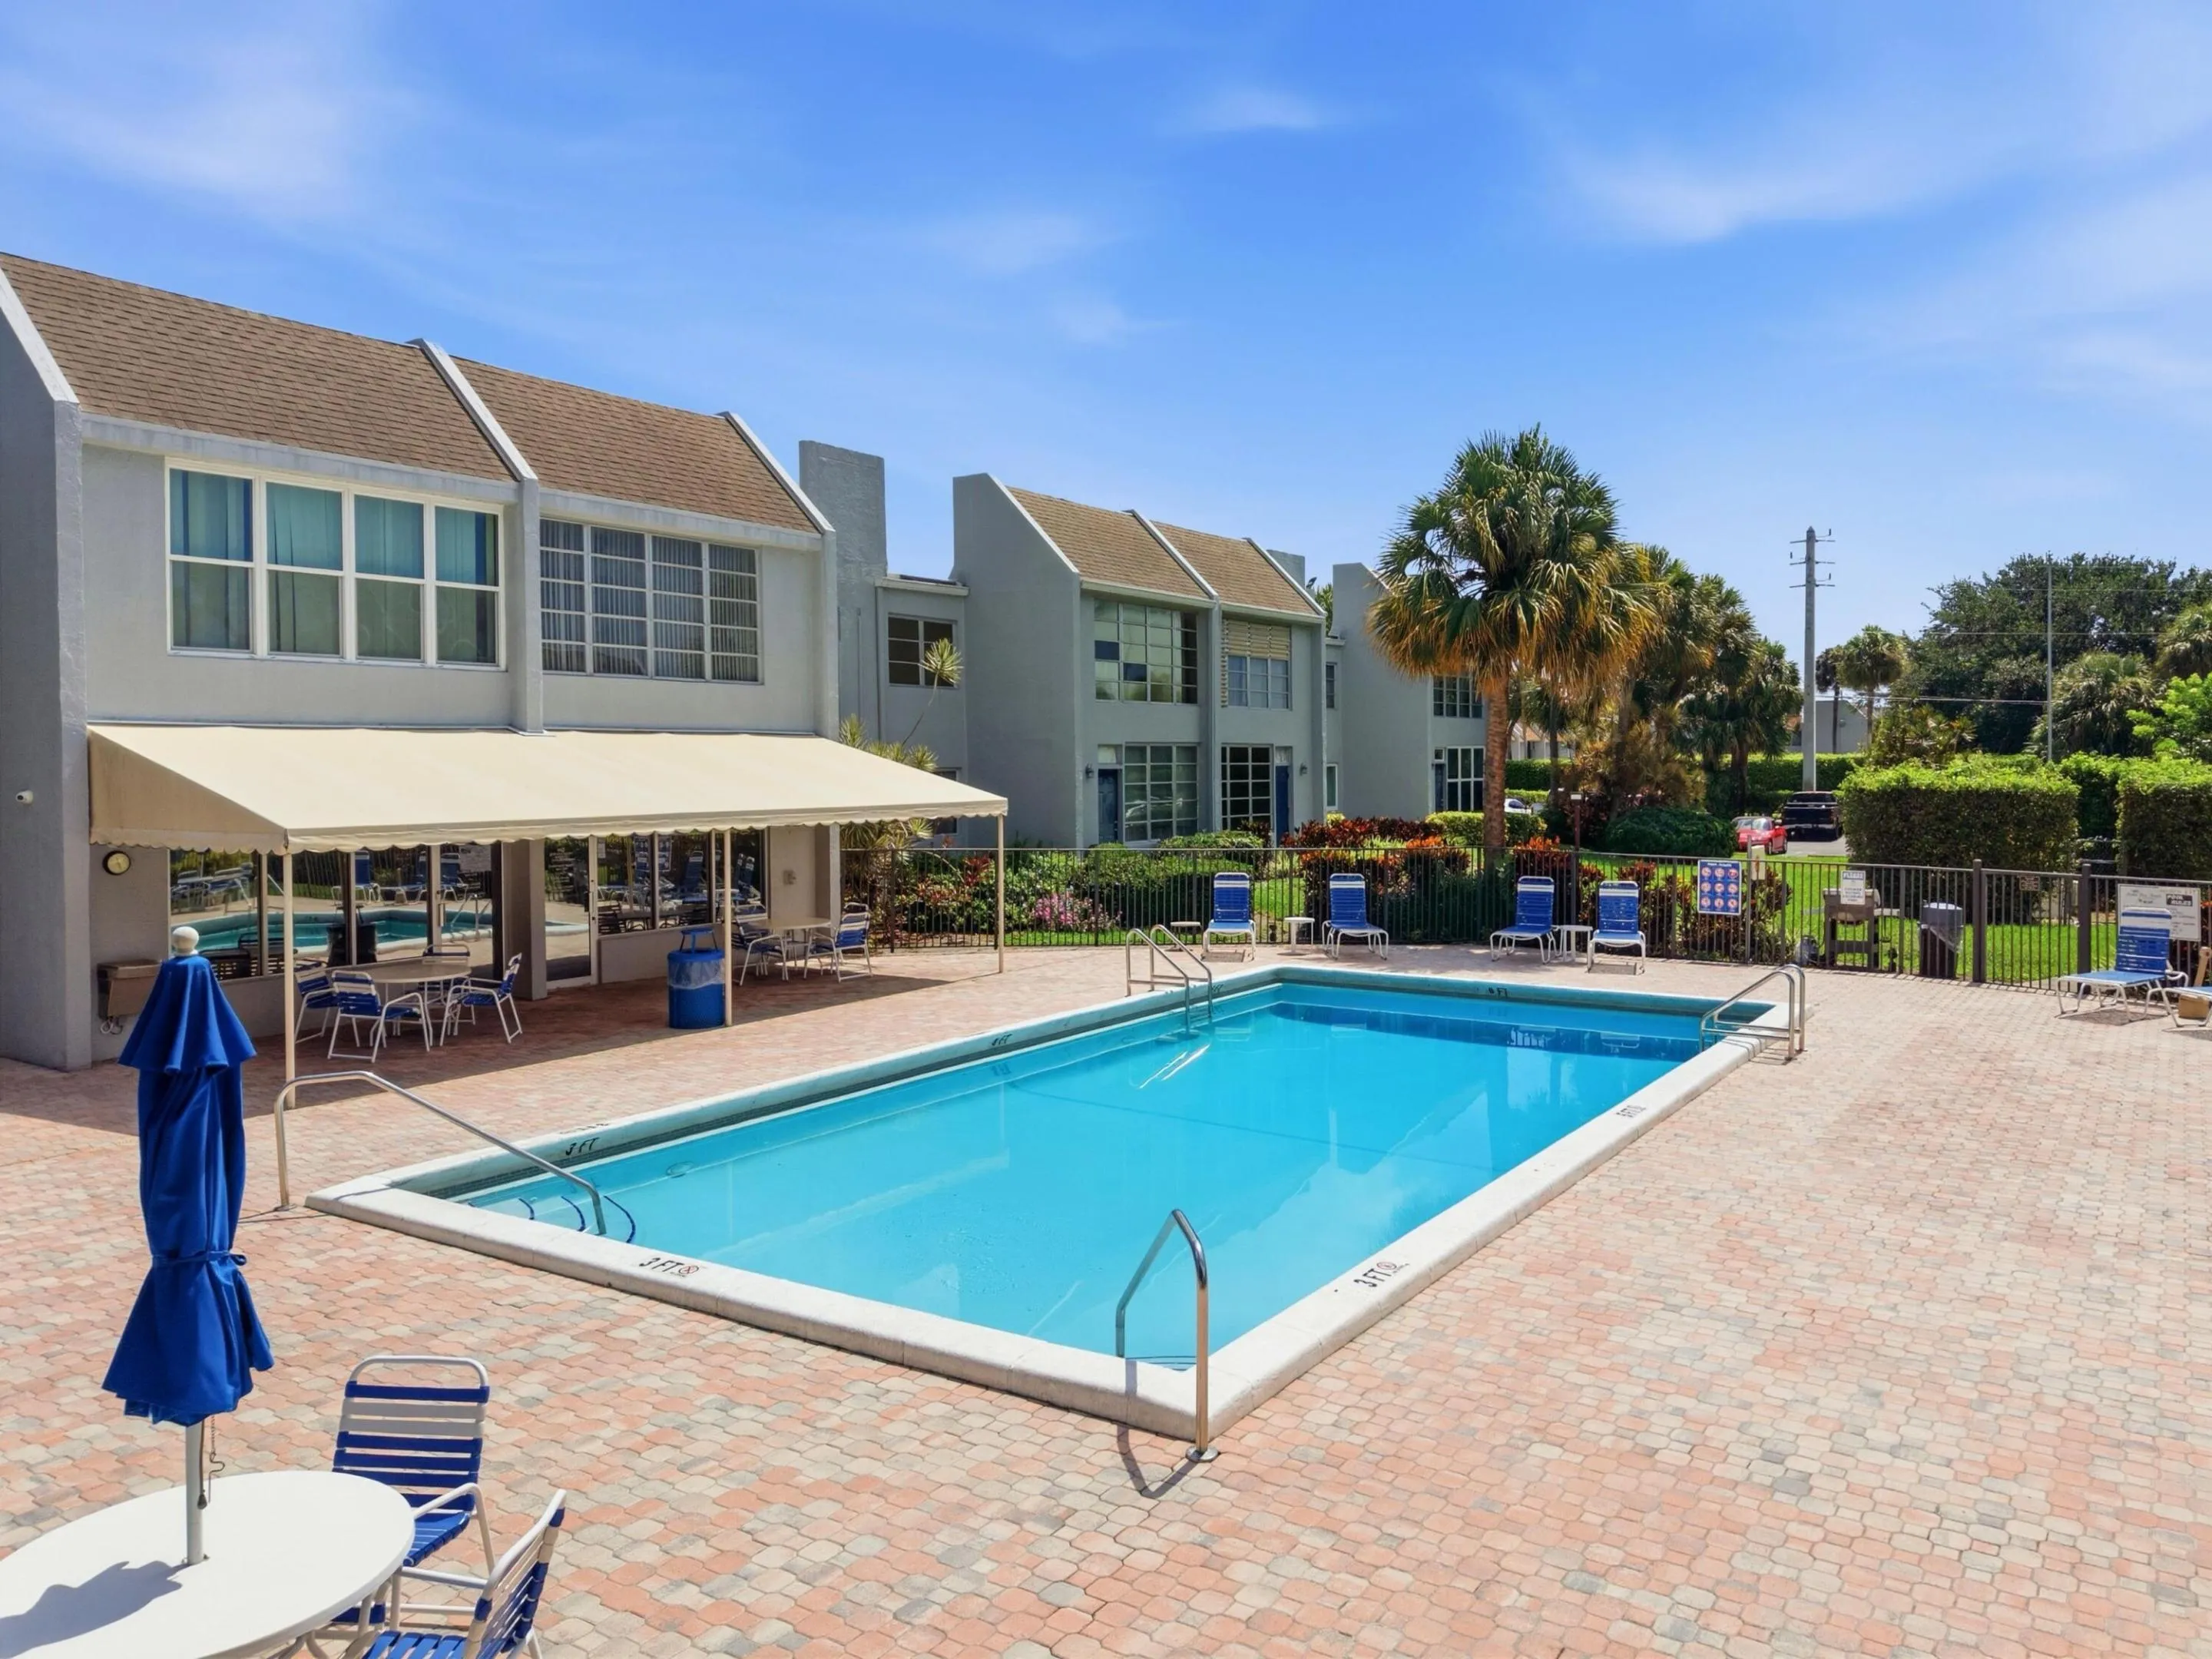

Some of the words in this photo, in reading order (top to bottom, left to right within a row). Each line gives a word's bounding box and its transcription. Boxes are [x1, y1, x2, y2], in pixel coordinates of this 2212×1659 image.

[651, 1260, 685, 1273] FT
[1363, 1268, 1392, 1282] FT
[1353, 1278, 1377, 1287] 3
